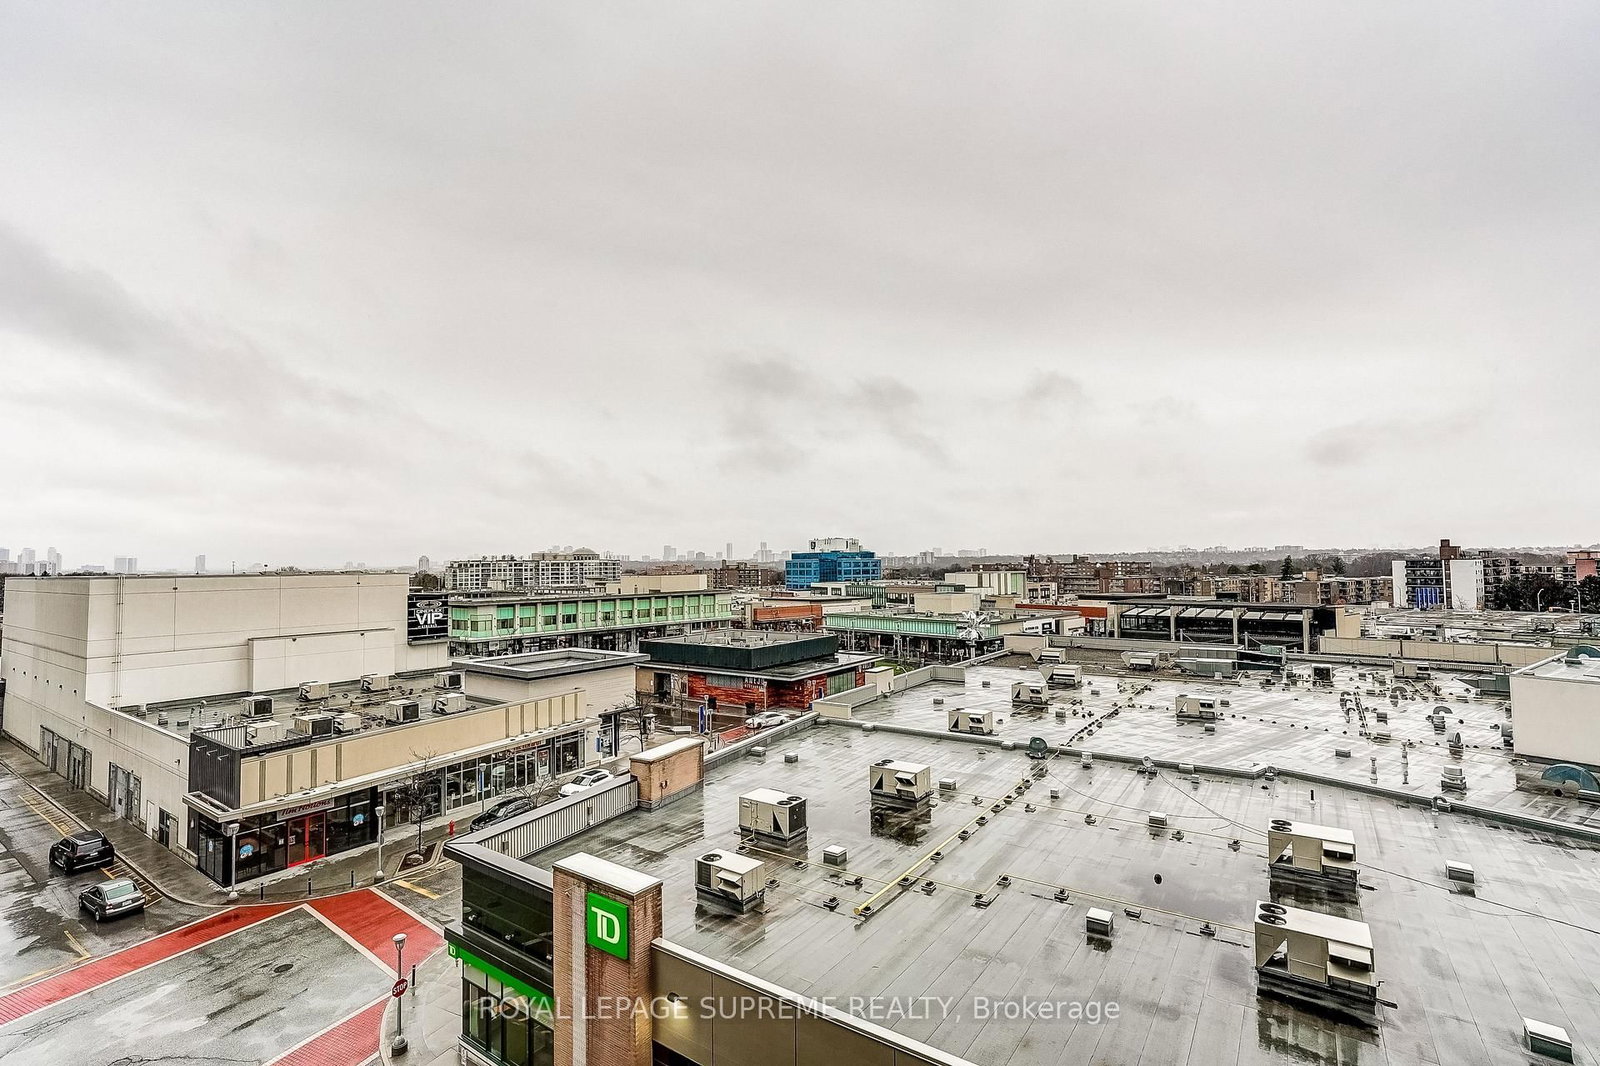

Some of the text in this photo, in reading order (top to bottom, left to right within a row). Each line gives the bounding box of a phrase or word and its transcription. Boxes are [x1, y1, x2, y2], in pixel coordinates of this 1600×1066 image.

[416, 612, 443, 625] VIP
[591, 906, 621, 945] TD
[393, 981, 408, 996] STOP
